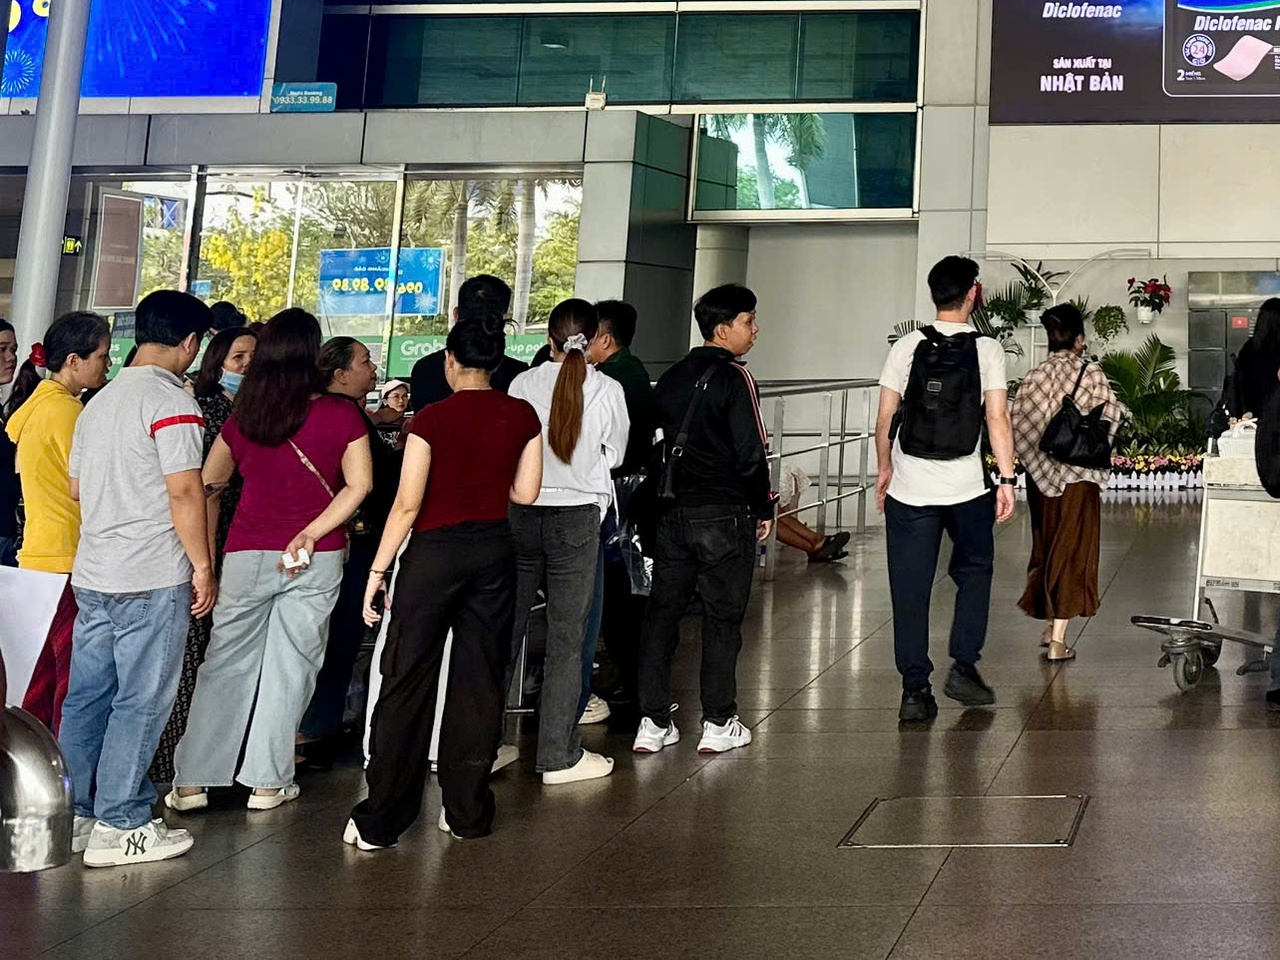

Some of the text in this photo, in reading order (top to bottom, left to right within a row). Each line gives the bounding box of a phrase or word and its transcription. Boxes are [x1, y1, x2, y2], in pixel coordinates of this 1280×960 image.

[1042, 2, 1122, 18] Diclofenac
[1193, 15, 1271, 31] Diclofenac
[1040, 71, 1124, 93] NHẬT BẢN
[1177, 69, 1186, 81] 2
